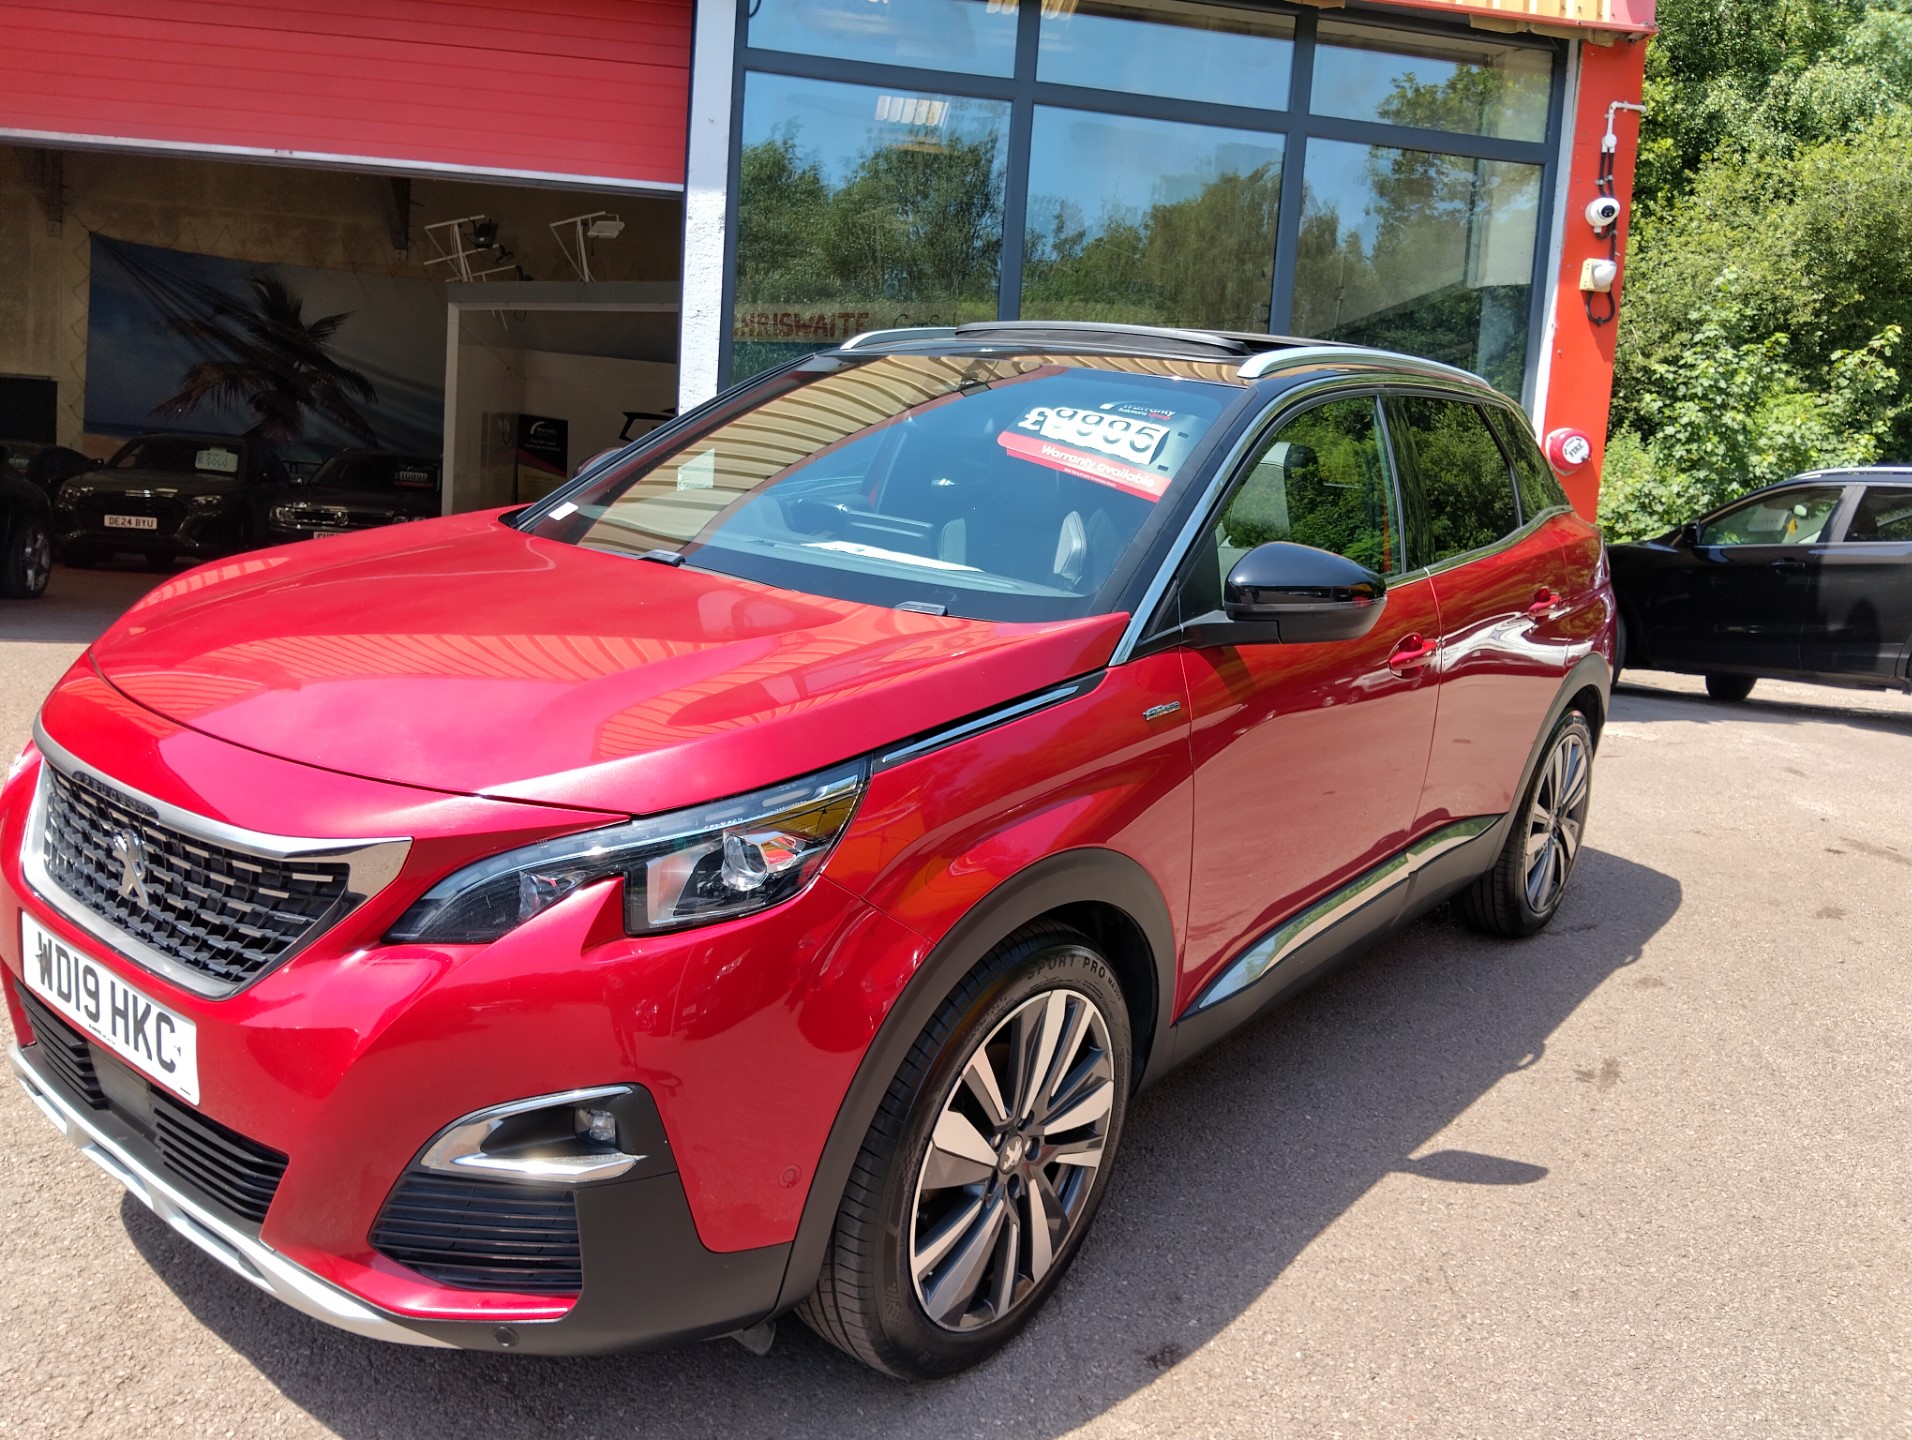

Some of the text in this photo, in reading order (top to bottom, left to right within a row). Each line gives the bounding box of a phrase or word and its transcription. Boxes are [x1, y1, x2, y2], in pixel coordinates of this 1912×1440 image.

[1568, 442, 1584, 458] FIRE
[1041, 444, 1095, 470] Warranty
[1097, 462, 1156, 488] available
[109, 516, 154, 528] DE24 BYU
[1027, 953, 1106, 980] SPORT PRO
[37, 931, 177, 1074] WD19 HKC
